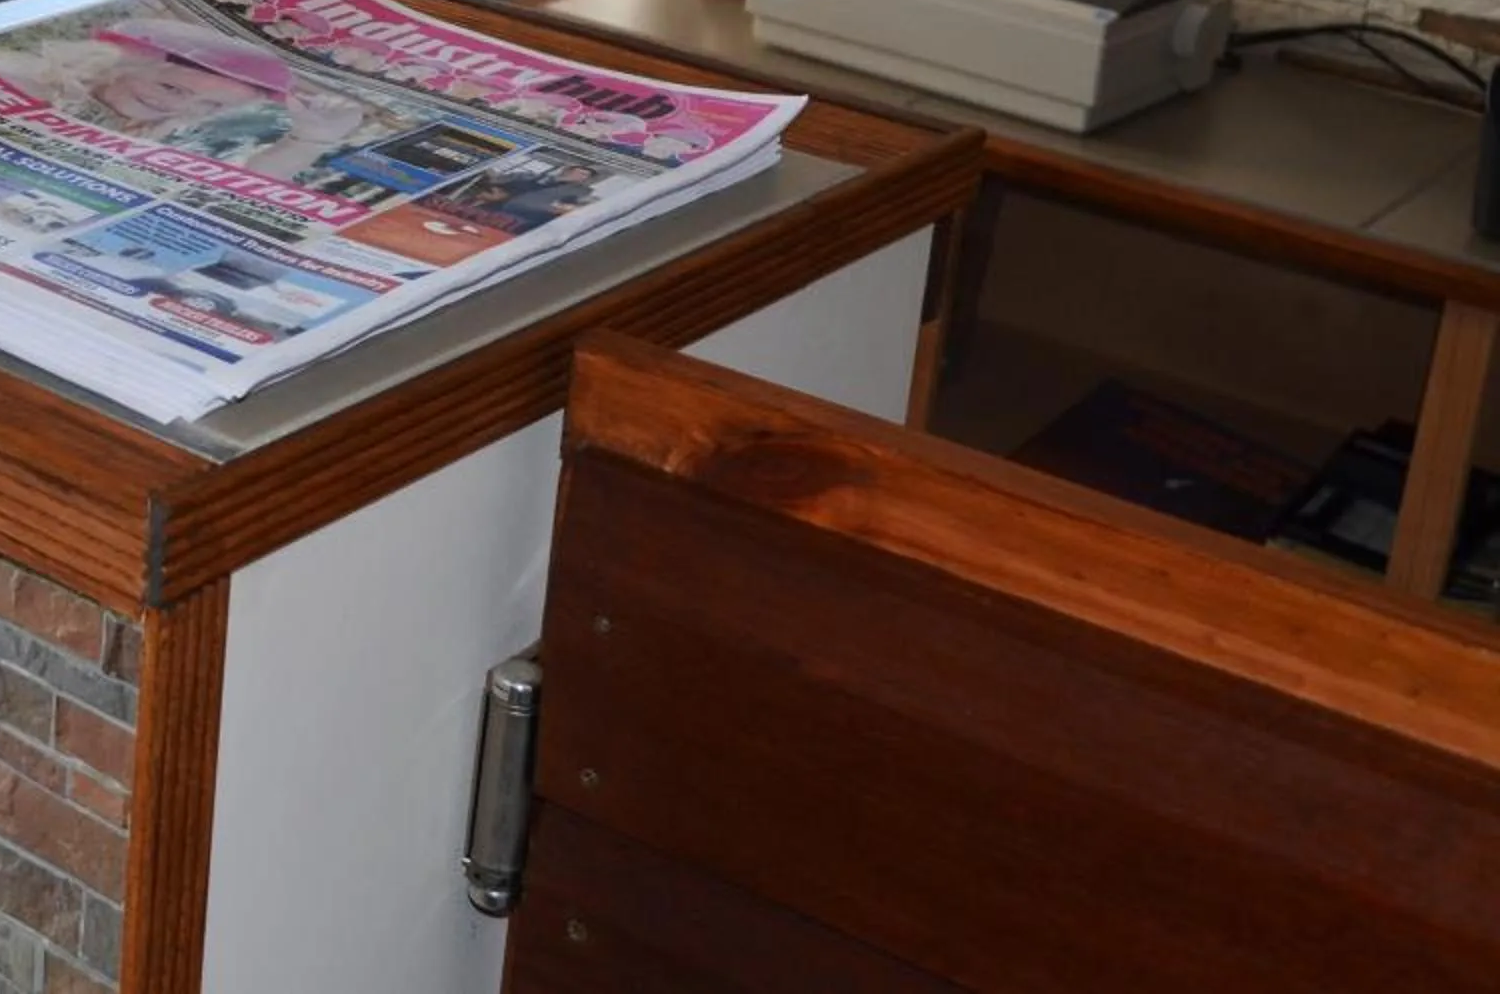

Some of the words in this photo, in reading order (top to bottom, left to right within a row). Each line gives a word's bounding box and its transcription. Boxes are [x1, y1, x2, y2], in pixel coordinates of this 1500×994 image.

[14, 149, 140, 205] SOLUTIONS
[26, 110, 138, 155] PINK
[143, 150, 360, 222] EDITION
